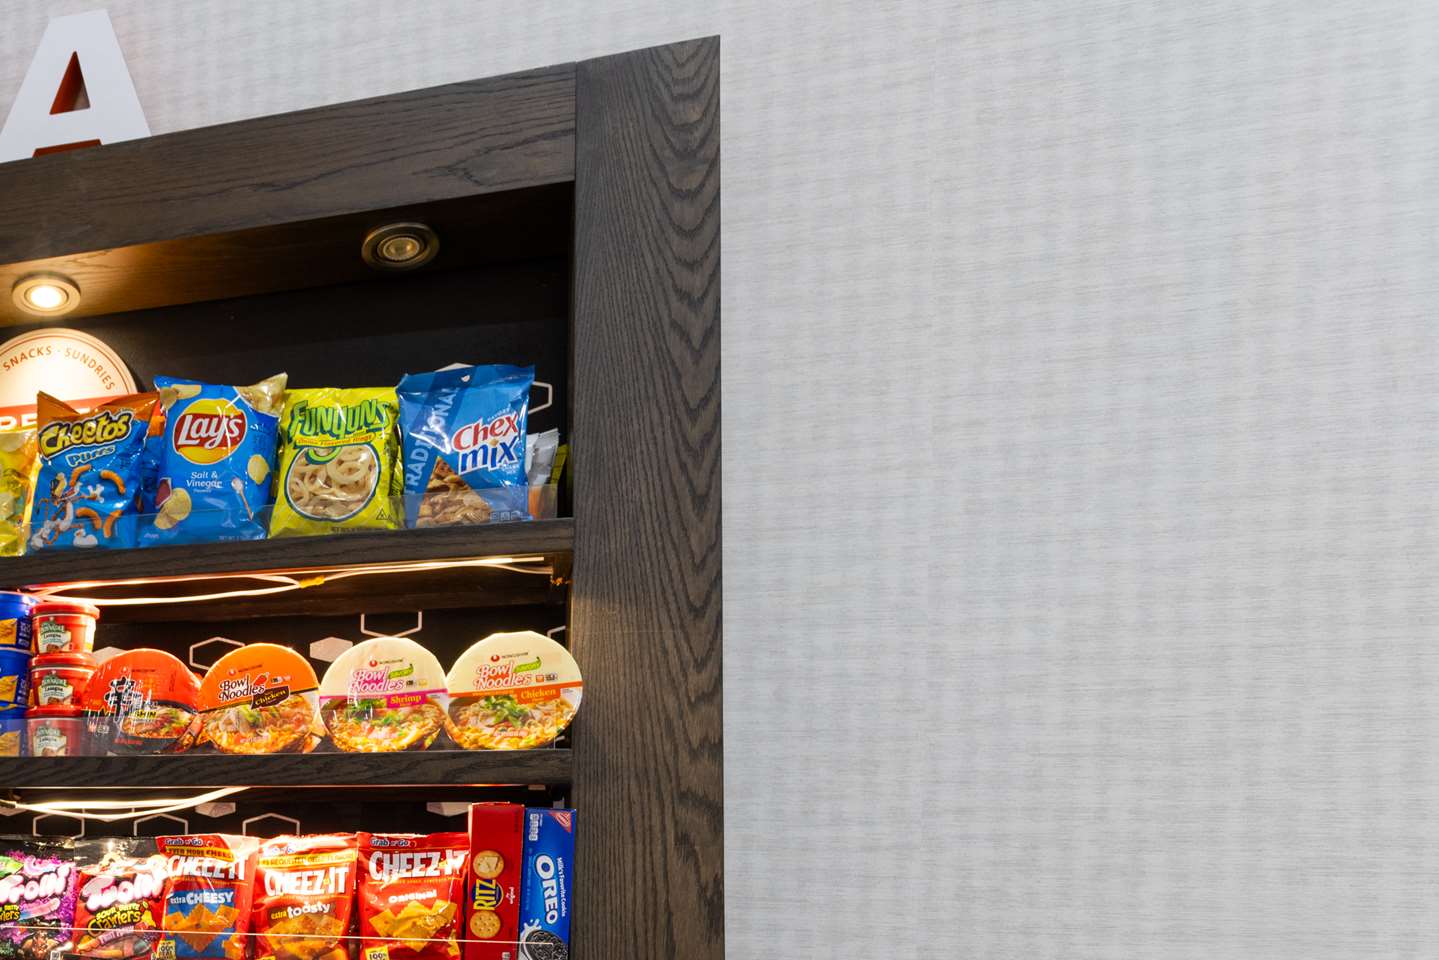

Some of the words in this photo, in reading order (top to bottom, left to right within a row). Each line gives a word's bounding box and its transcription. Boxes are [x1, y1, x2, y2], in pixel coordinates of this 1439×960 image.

[2, 345, 53, 372] SNACKS
[64, 347, 117, 393] SUNDRIES
[288, 400, 390, 442] FUNYUNS
[39, 412, 134, 460] Cheetos
[176, 413, 243, 450] Lay's
[452, 413, 519, 451] Chex
[459, 436, 519, 475] mix
[190, 471, 210, 480] Salt
[210, 471, 219, 480] &
[186, 479, 223, 490] Vinegar
[353, 666, 390, 681] Bowl
[475, 661, 515, 678] Bowl
[219, 674, 250, 691] Bowl
[351, 679, 406, 693] Noodles
[474, 673, 533, 690] Noodles
[218, 684, 266, 702] Noodles
[255, 689, 287, 706] Chicken
[390, 694, 422, 706] Shrimp
[520, 688, 557, 700] Chicken
[370, 838, 389, 847] Grab
[399, 838, 410, 847] Go
[185, 891, 234, 905] CHEESY
[473, 879, 497, 911] RITZ
[535, 854, 559, 925] OREO
[96, 907, 117, 920] SOUR
[270, 911, 288, 920] extra
[287, 902, 331, 920] toasty
[87, 910, 142, 937] Crawlers
